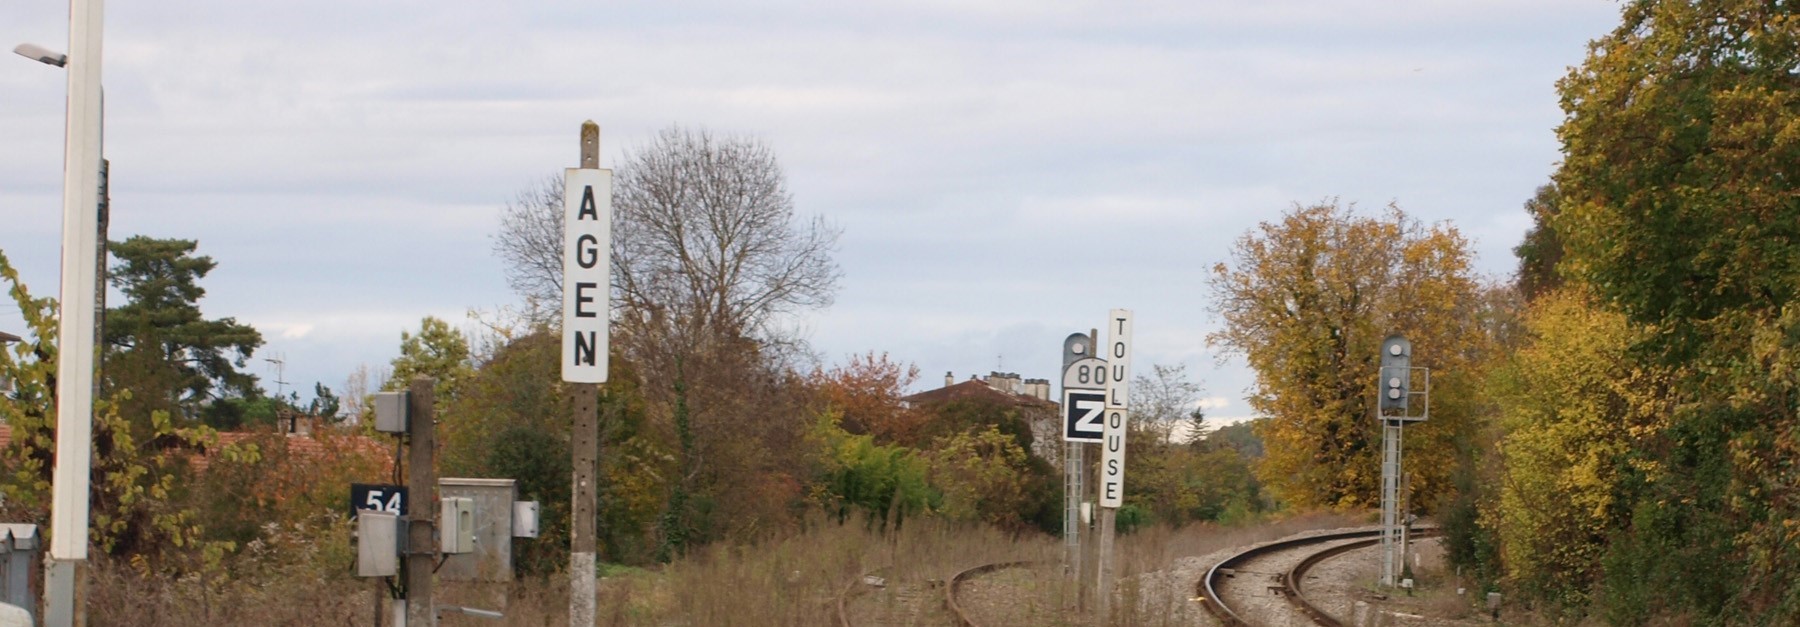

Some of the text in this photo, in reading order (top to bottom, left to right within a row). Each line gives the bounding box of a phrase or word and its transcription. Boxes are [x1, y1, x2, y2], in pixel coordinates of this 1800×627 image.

[574, 185, 598, 366] AGEN
[1078, 365, 1106, 385] 80
[1075, 400, 1105, 432] Z
[1106, 318, 1126, 499] TOULOUSE
[366, 490, 401, 516] 54
